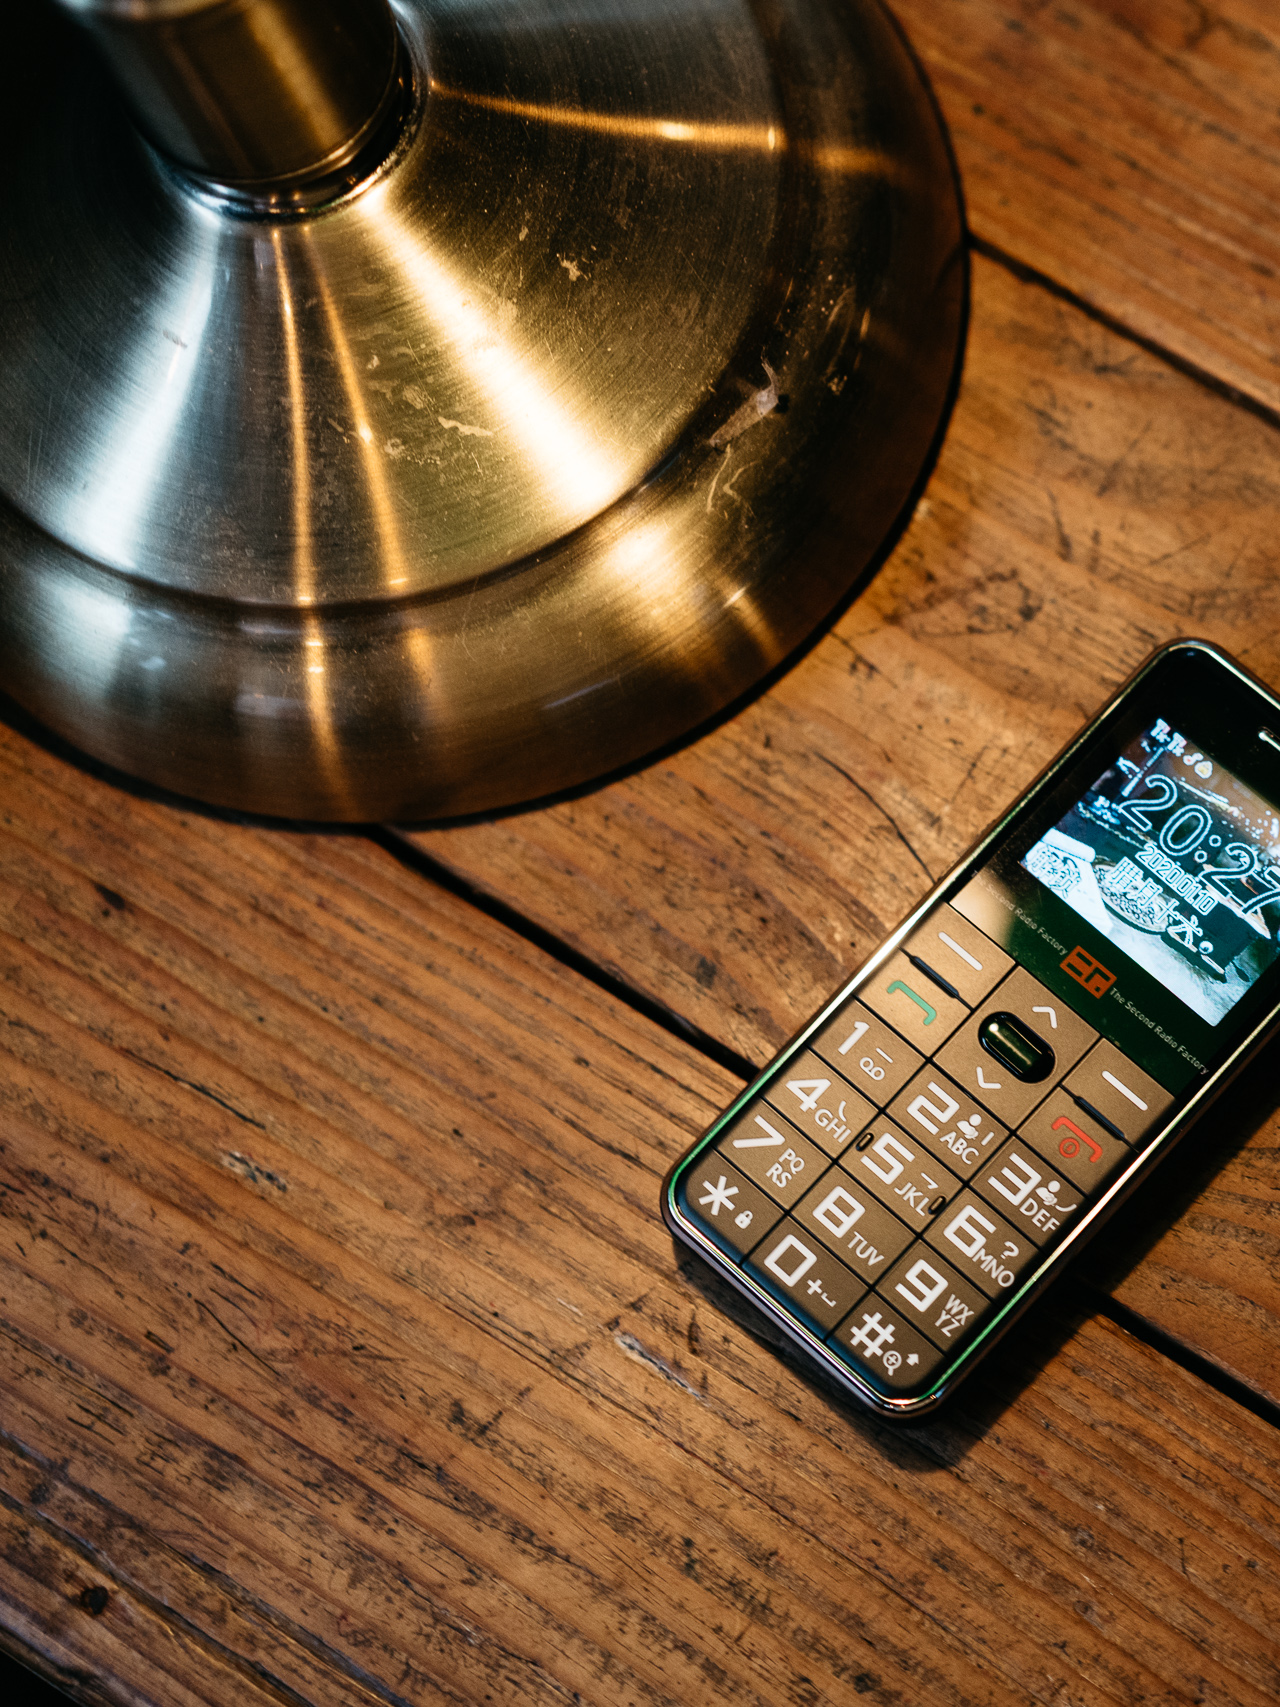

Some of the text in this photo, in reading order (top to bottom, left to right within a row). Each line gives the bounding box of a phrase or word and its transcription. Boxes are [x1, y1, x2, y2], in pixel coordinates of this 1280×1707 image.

[987, 880, 1016, 911] Second
[1014, 907, 1039, 931] Radio
[1037, 926, 1069, 956] Factory
[837, 1021, 870, 1056] 1
[1109, 986, 1210, 1075] The Second Radio Factory
[785, 1078, 832, 1113] 4
[906, 1081, 961, 1136] 2
[732, 1114, 786, 1149] 7
[814, 1108, 852, 1144] GHI
[778, 1147, 805, 1174] PQ
[860, 1132, 916, 1185] 5
[939, 1131, 980, 1165] ABC
[765, 1162, 793, 1188] RS
[987, 1152, 1042, 1207] 3
[812, 1185, 866, 1239] 8
[893, 1182, 930, 1217] JKL
[1019, 1197, 1061, 1233] DEF
[847, 1231, 885, 1267] TUV
[943, 1204, 997, 1258] 6
[971, 1246, 1015, 1288] MNO
[894, 1259, 949, 1313] 9
[935, 1309, 961, 1338] YZ
[944, 1293, 975, 1326] WX
